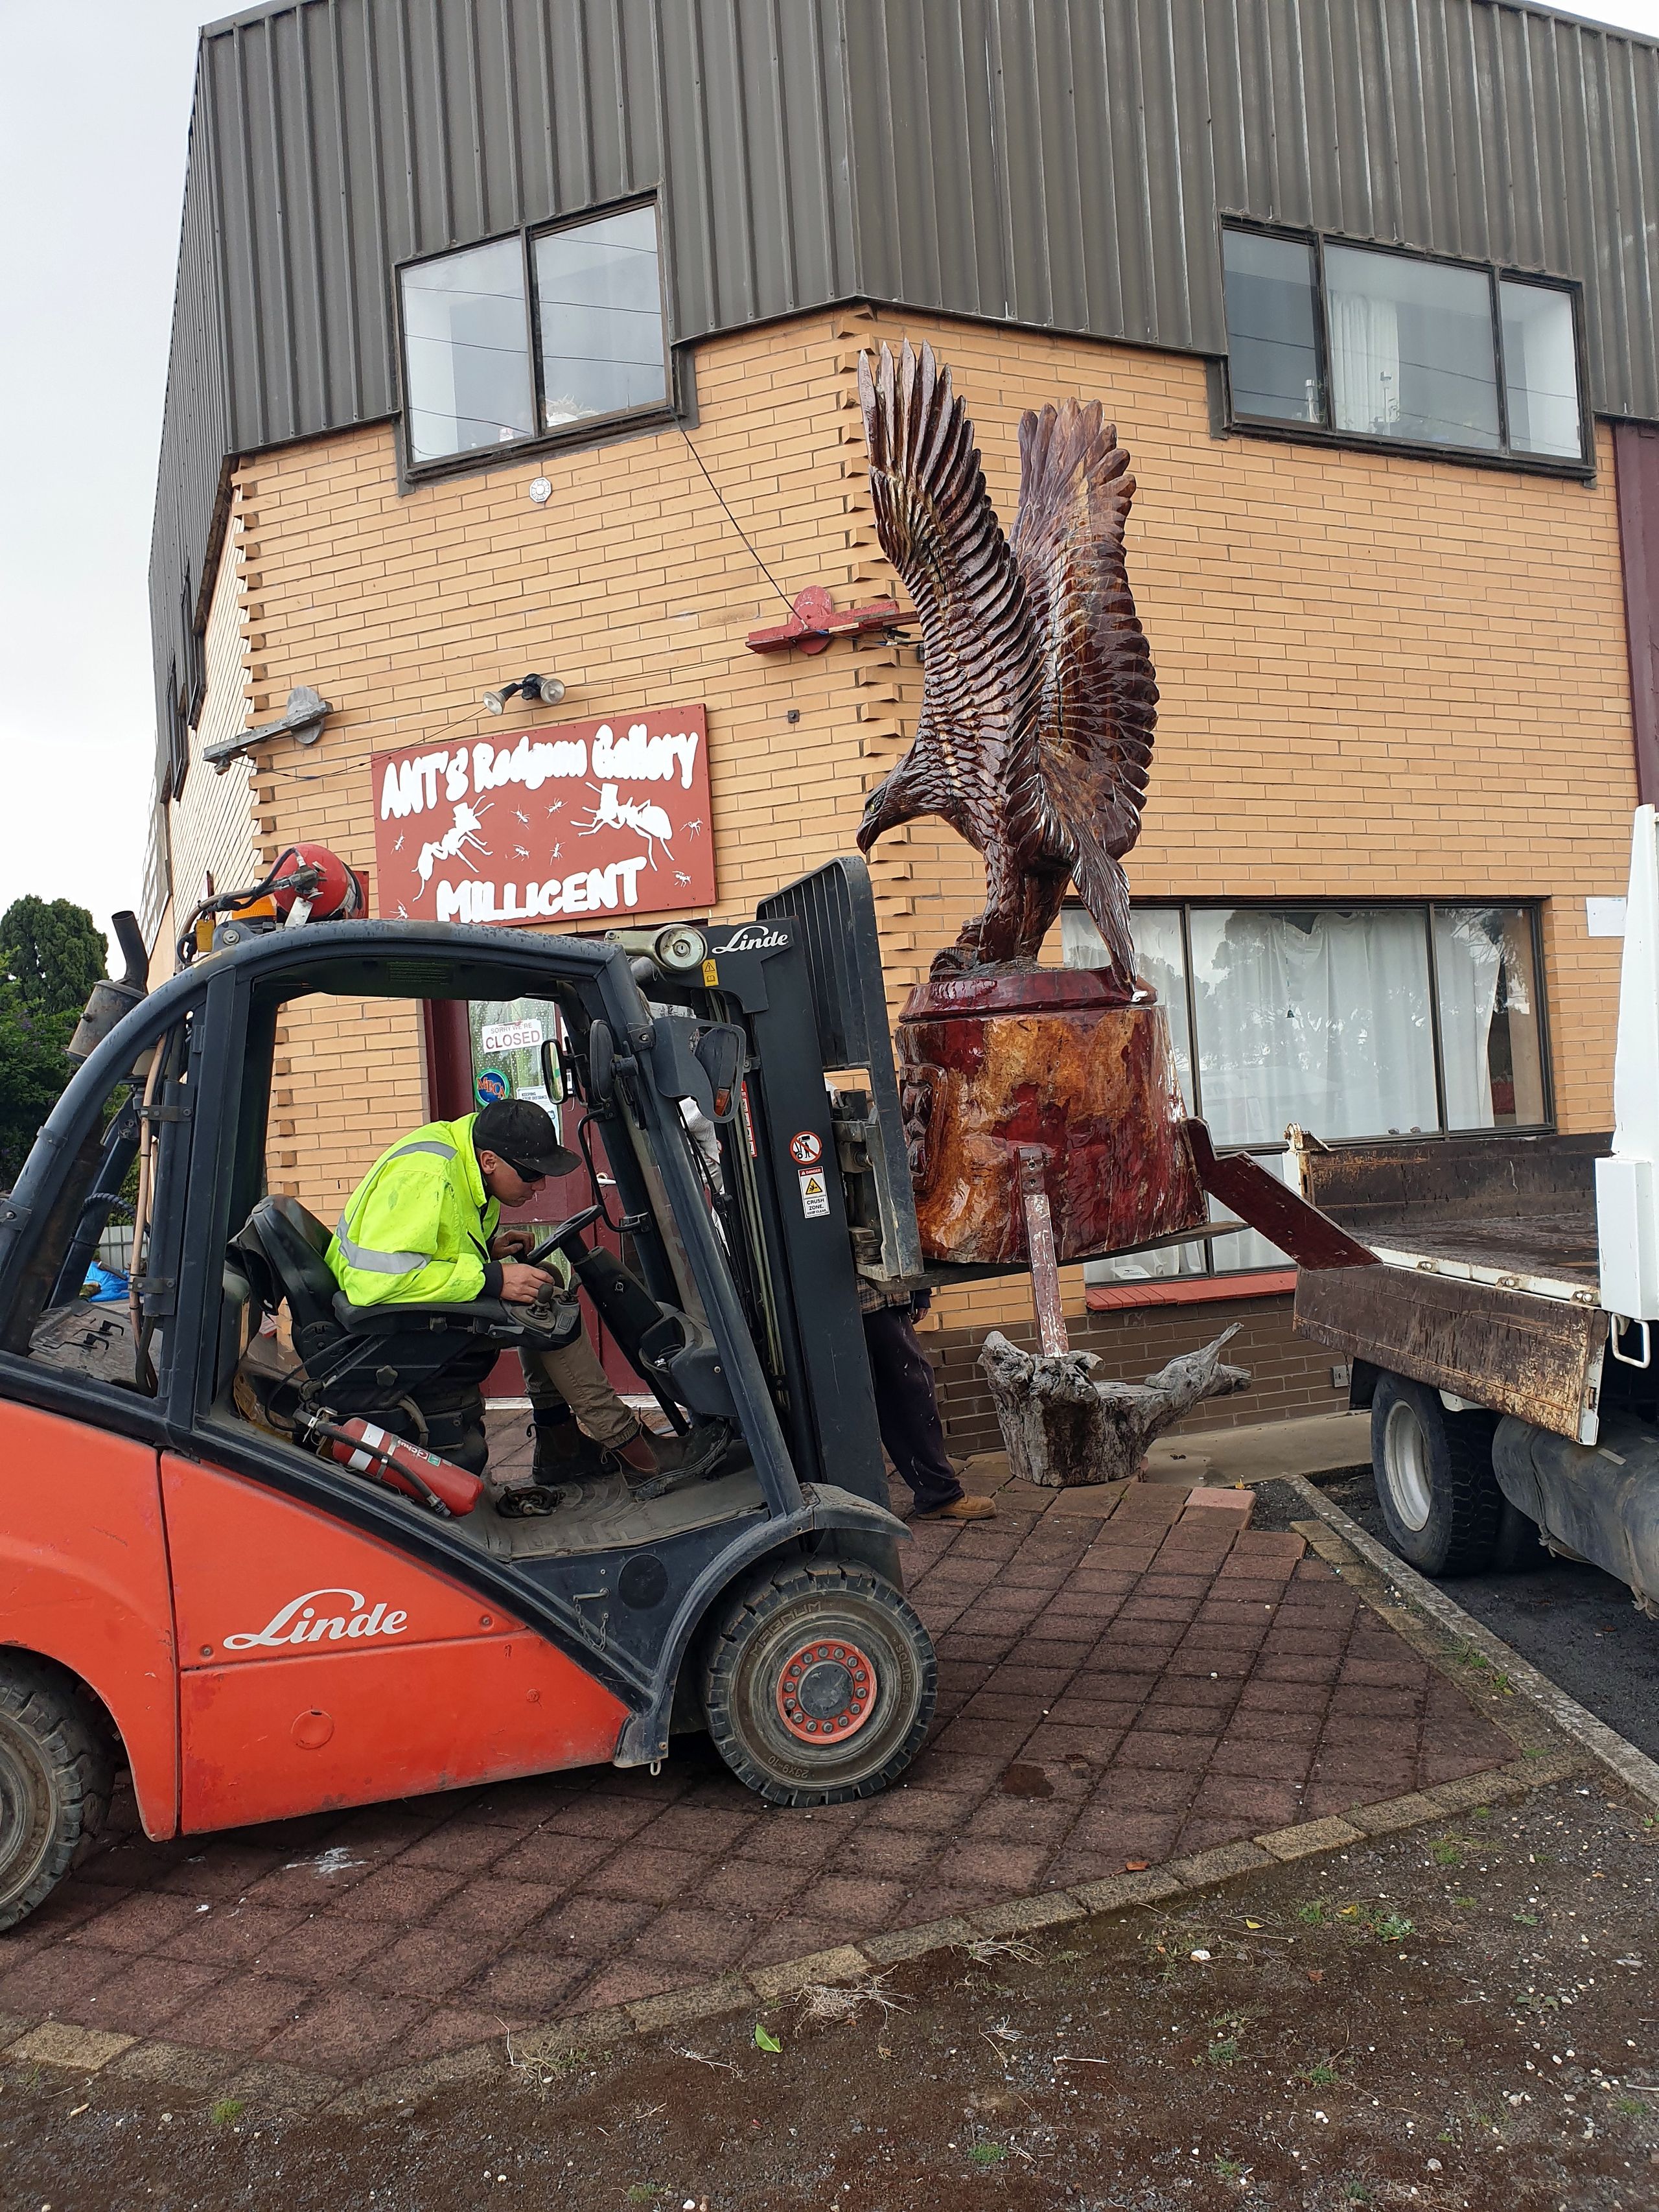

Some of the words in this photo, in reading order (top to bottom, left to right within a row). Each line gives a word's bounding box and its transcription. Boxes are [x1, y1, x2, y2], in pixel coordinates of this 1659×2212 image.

[437, 856, 647, 924] MILLICENT
[712, 926, 789, 954] Linde
[486, 1030, 540, 1049] CLOSED
[512, 1022, 532, 1030] WE'RE
[477, 1077, 506, 1099] MBCA
[223, 1589, 408, 1649] Linde
[749, 1600, 822, 1658] MAGNUM
